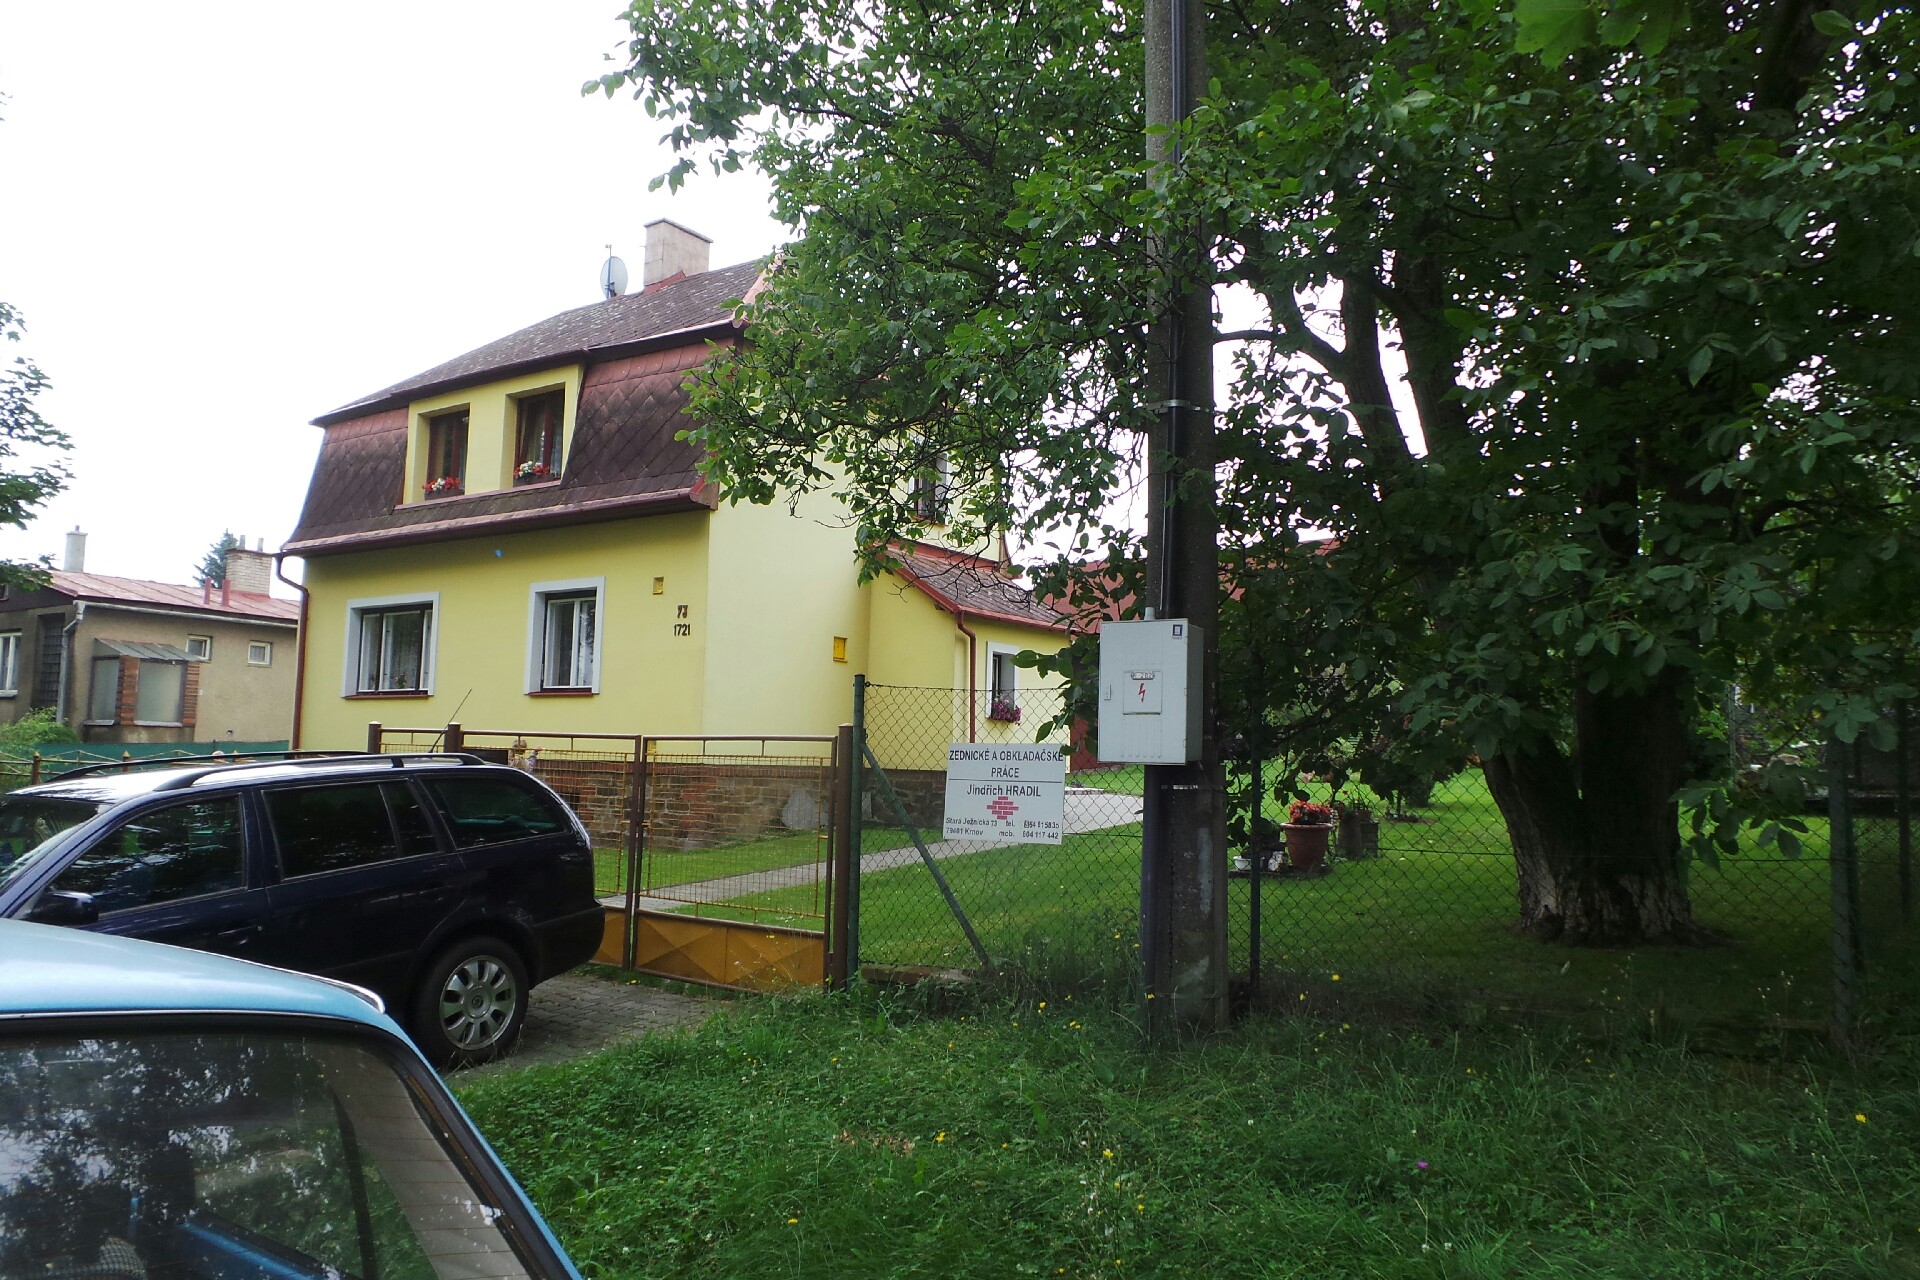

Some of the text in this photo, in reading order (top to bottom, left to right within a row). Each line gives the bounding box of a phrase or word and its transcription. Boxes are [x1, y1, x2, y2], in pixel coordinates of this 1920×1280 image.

[677, 604, 688, 619] 73
[673, 623, 691, 637] 1721
[949, 748, 990, 761] ZEDNICKÉ
[991, 750, 998, 761] A
[991, 764, 1020, 778] PRÁCE
[966, 784, 1041, 797] Jindřich HRADIL
[964, 828, 984, 836] Krnov
